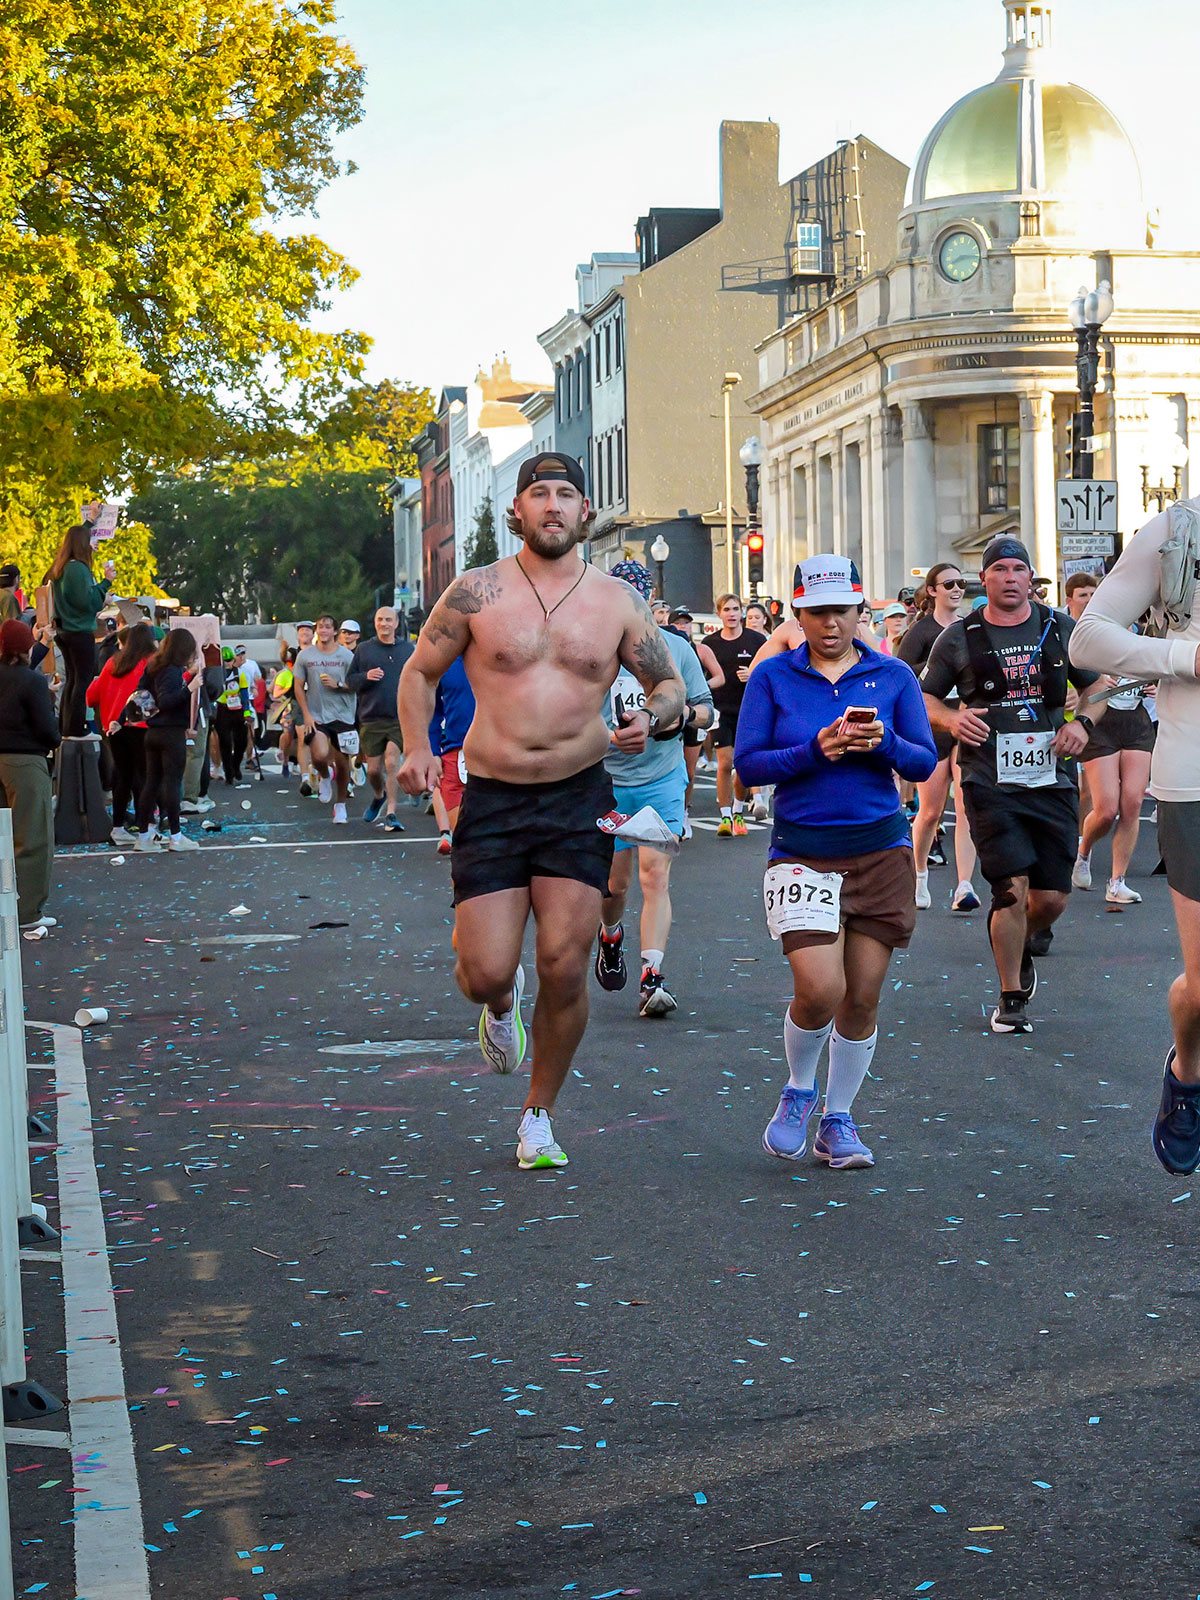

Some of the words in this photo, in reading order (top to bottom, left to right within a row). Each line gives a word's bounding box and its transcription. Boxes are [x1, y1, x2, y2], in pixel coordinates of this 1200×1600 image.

[956, 356, 987, 367] BANK
[1001, 646, 1021, 655] CORPS
[1001, 748, 1052, 767] 18431
[766, 883, 834, 911] 31972
